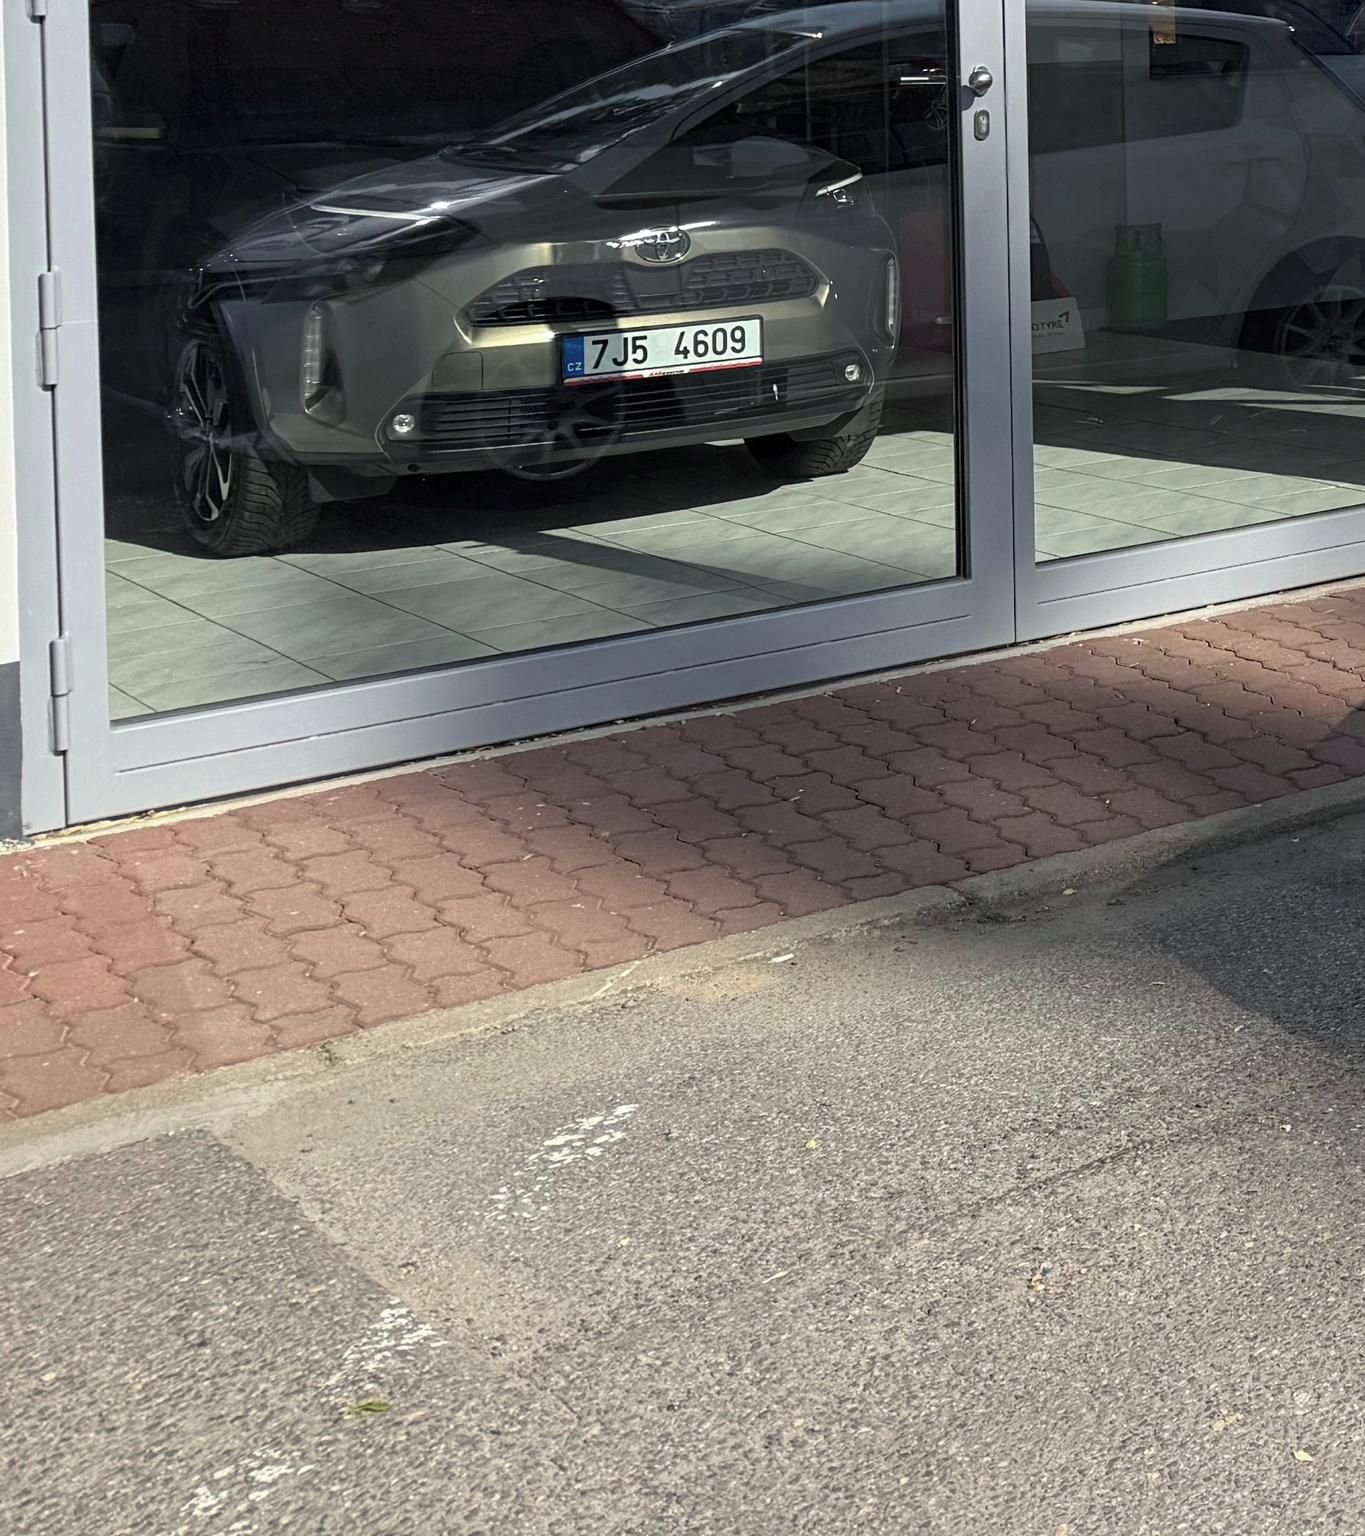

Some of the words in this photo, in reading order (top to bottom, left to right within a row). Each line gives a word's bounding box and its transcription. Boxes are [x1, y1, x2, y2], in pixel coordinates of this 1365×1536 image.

[591, 335, 648, 370] 7J5
[674, 325, 746, 360] 4609
[567, 361, 582, 372] CZ
